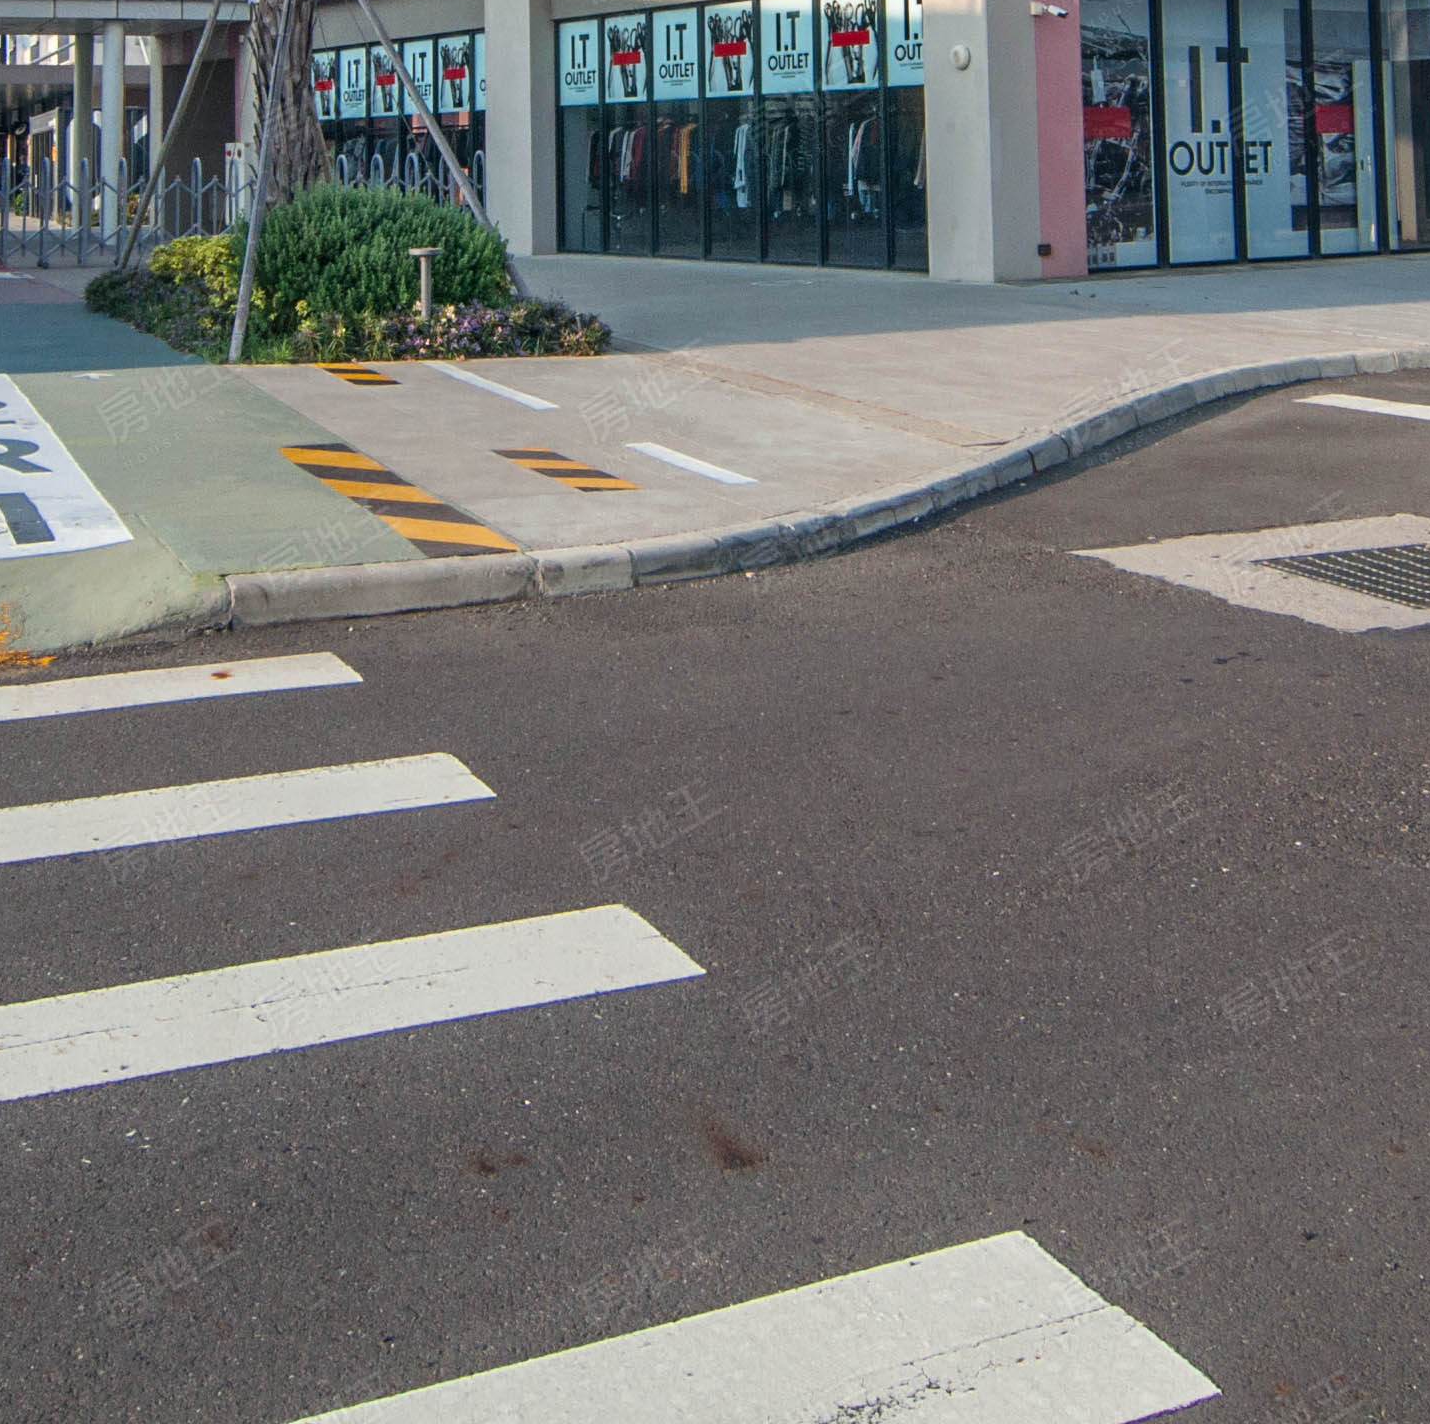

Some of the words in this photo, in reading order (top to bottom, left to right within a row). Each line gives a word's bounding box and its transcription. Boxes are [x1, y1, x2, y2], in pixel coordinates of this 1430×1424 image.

[666, 23, 687, 61] I.T
[776, 10, 800, 51] I.T
[571, 34, 589, 69] I.T
[768, 53, 809, 71] OUTLET
[564, 70, 596, 86] OUTLET
[658, 62, 695, 79] OUTLET
[342, 89, 365, 102] OUTLET
[1169, 140, 1272, 176] OUTET
